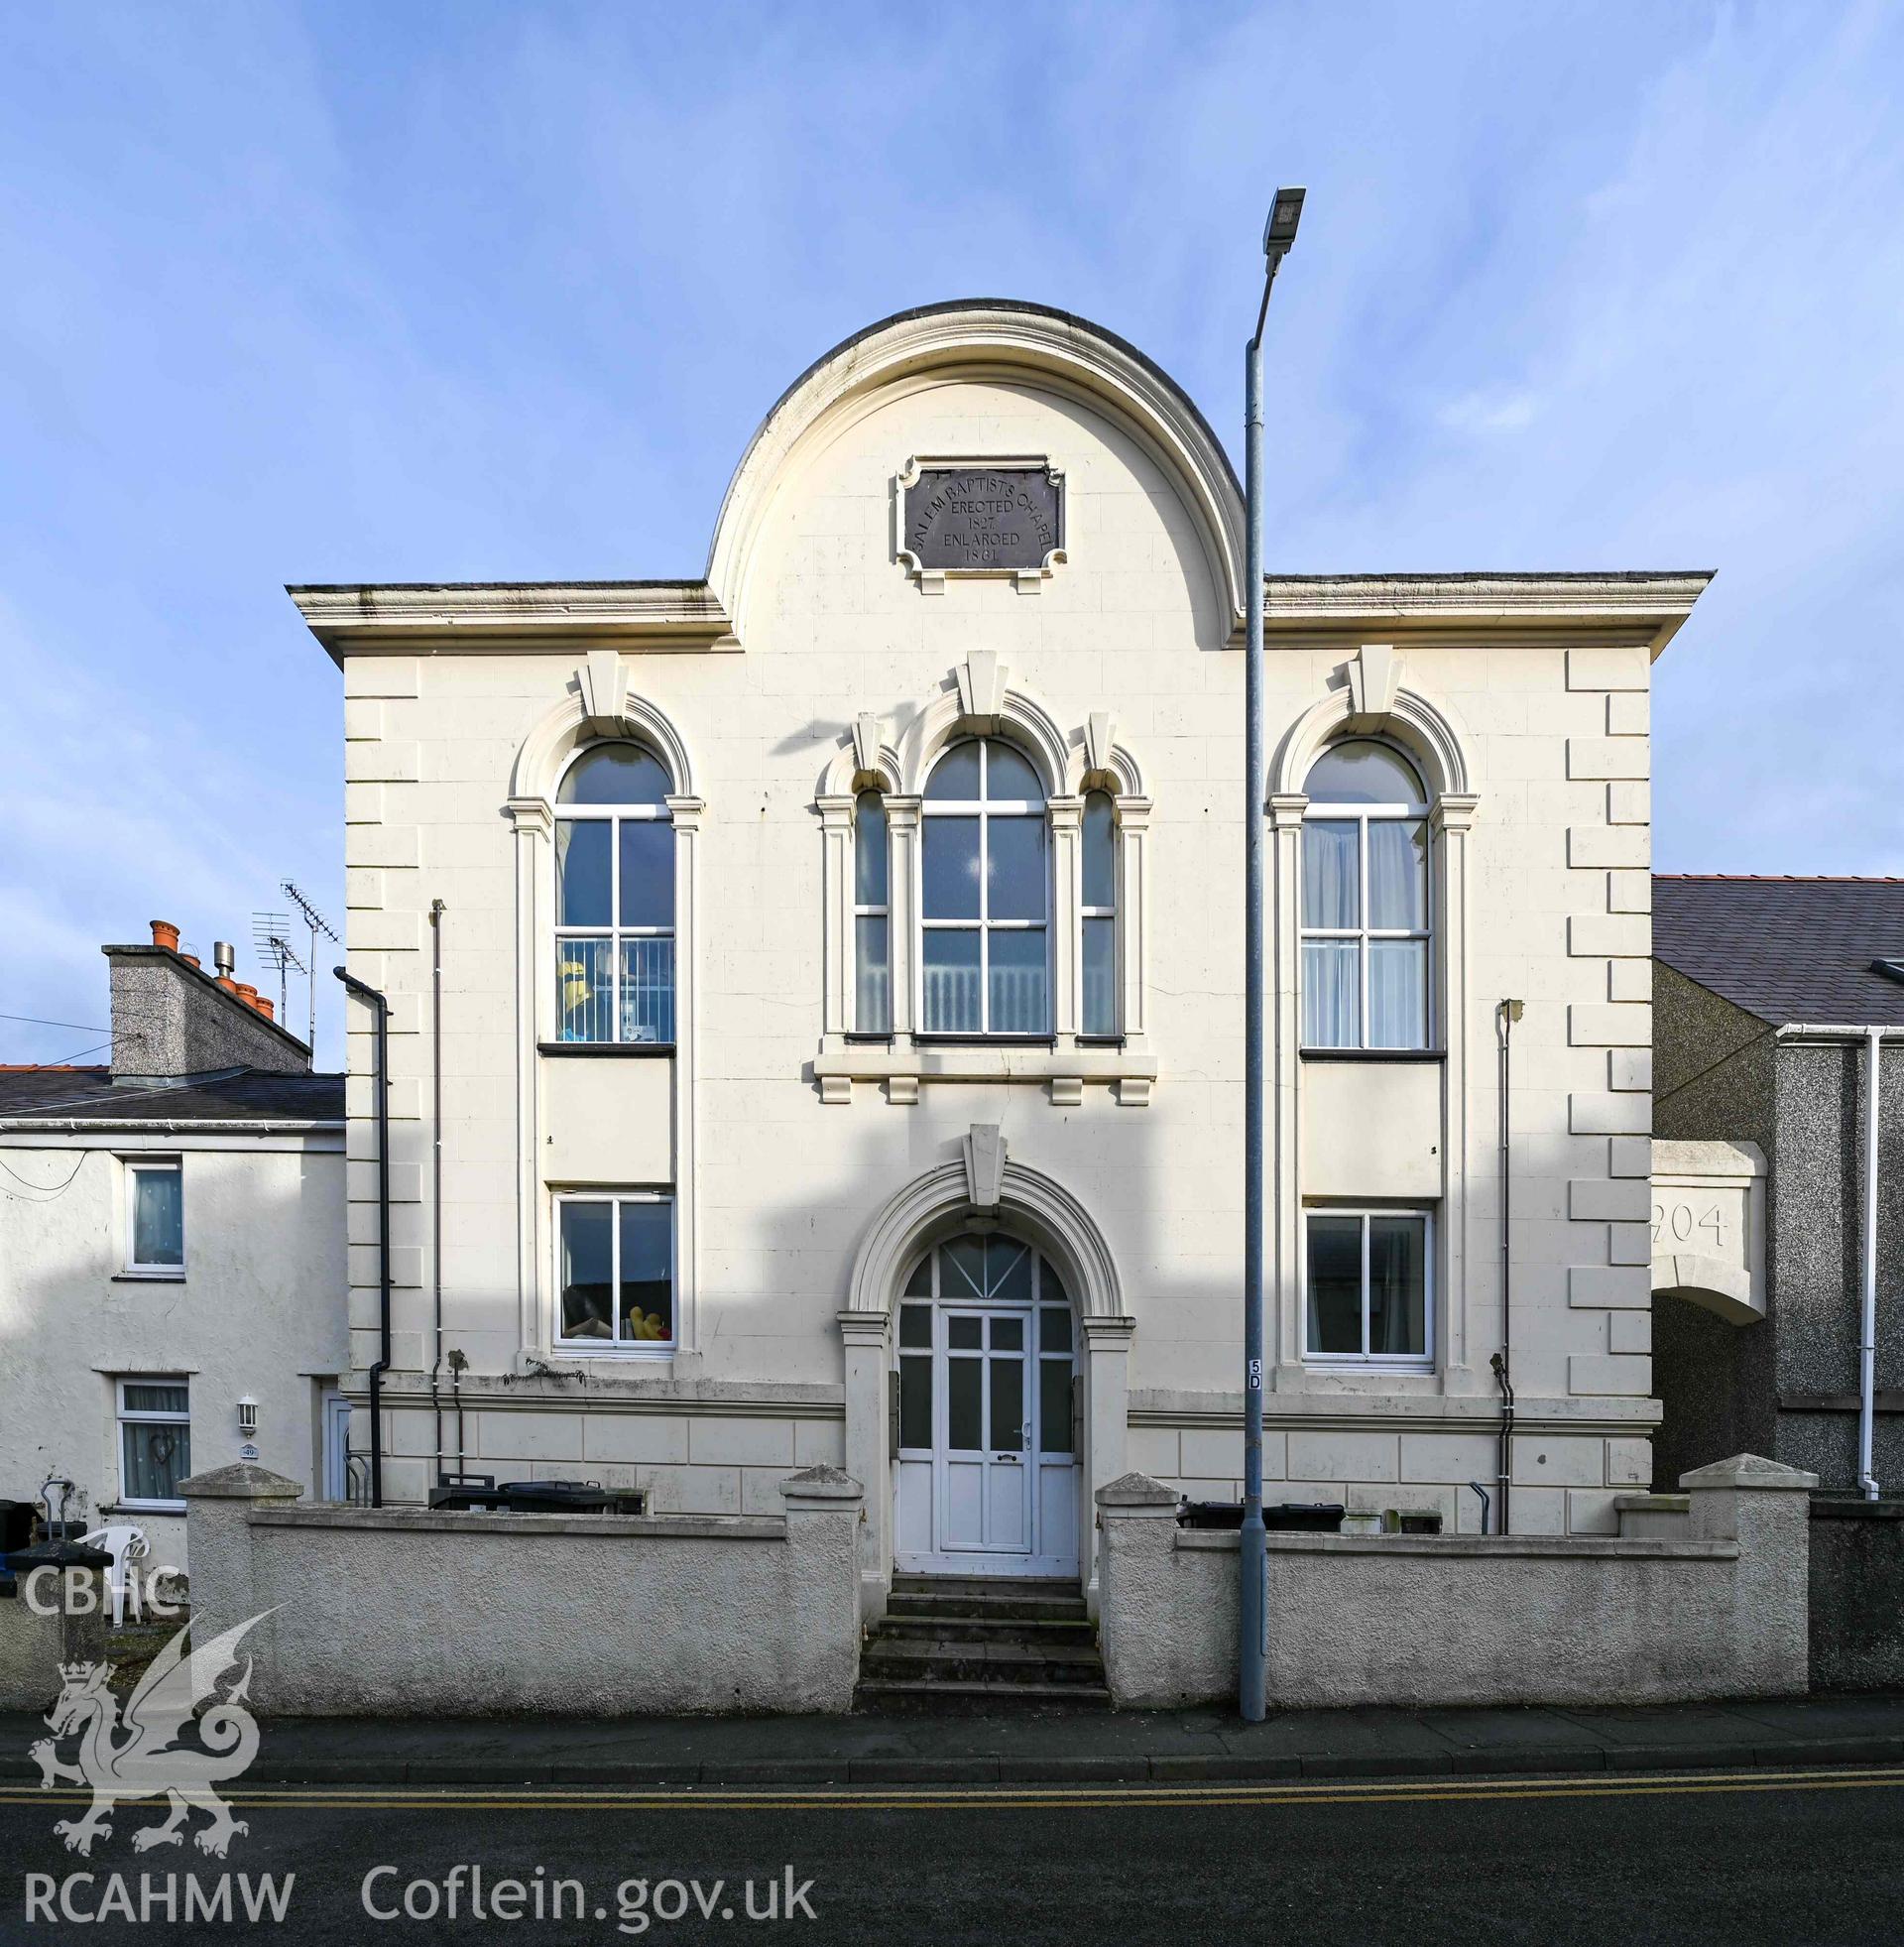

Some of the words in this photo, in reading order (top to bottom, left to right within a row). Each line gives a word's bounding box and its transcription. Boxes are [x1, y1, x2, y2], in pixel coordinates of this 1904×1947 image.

[952, 501, 1013, 513] ERECTED
[912, 497, 946, 551] SALEM
[946, 477, 1015, 501] BAPTISTS
[1016, 493, 1055, 551] CHAPEL
[944, 533, 1019, 547] ENLARGED
[1253, 1361, 1259, 1372] 5
[1250, 1375, 1260, 1388] D
